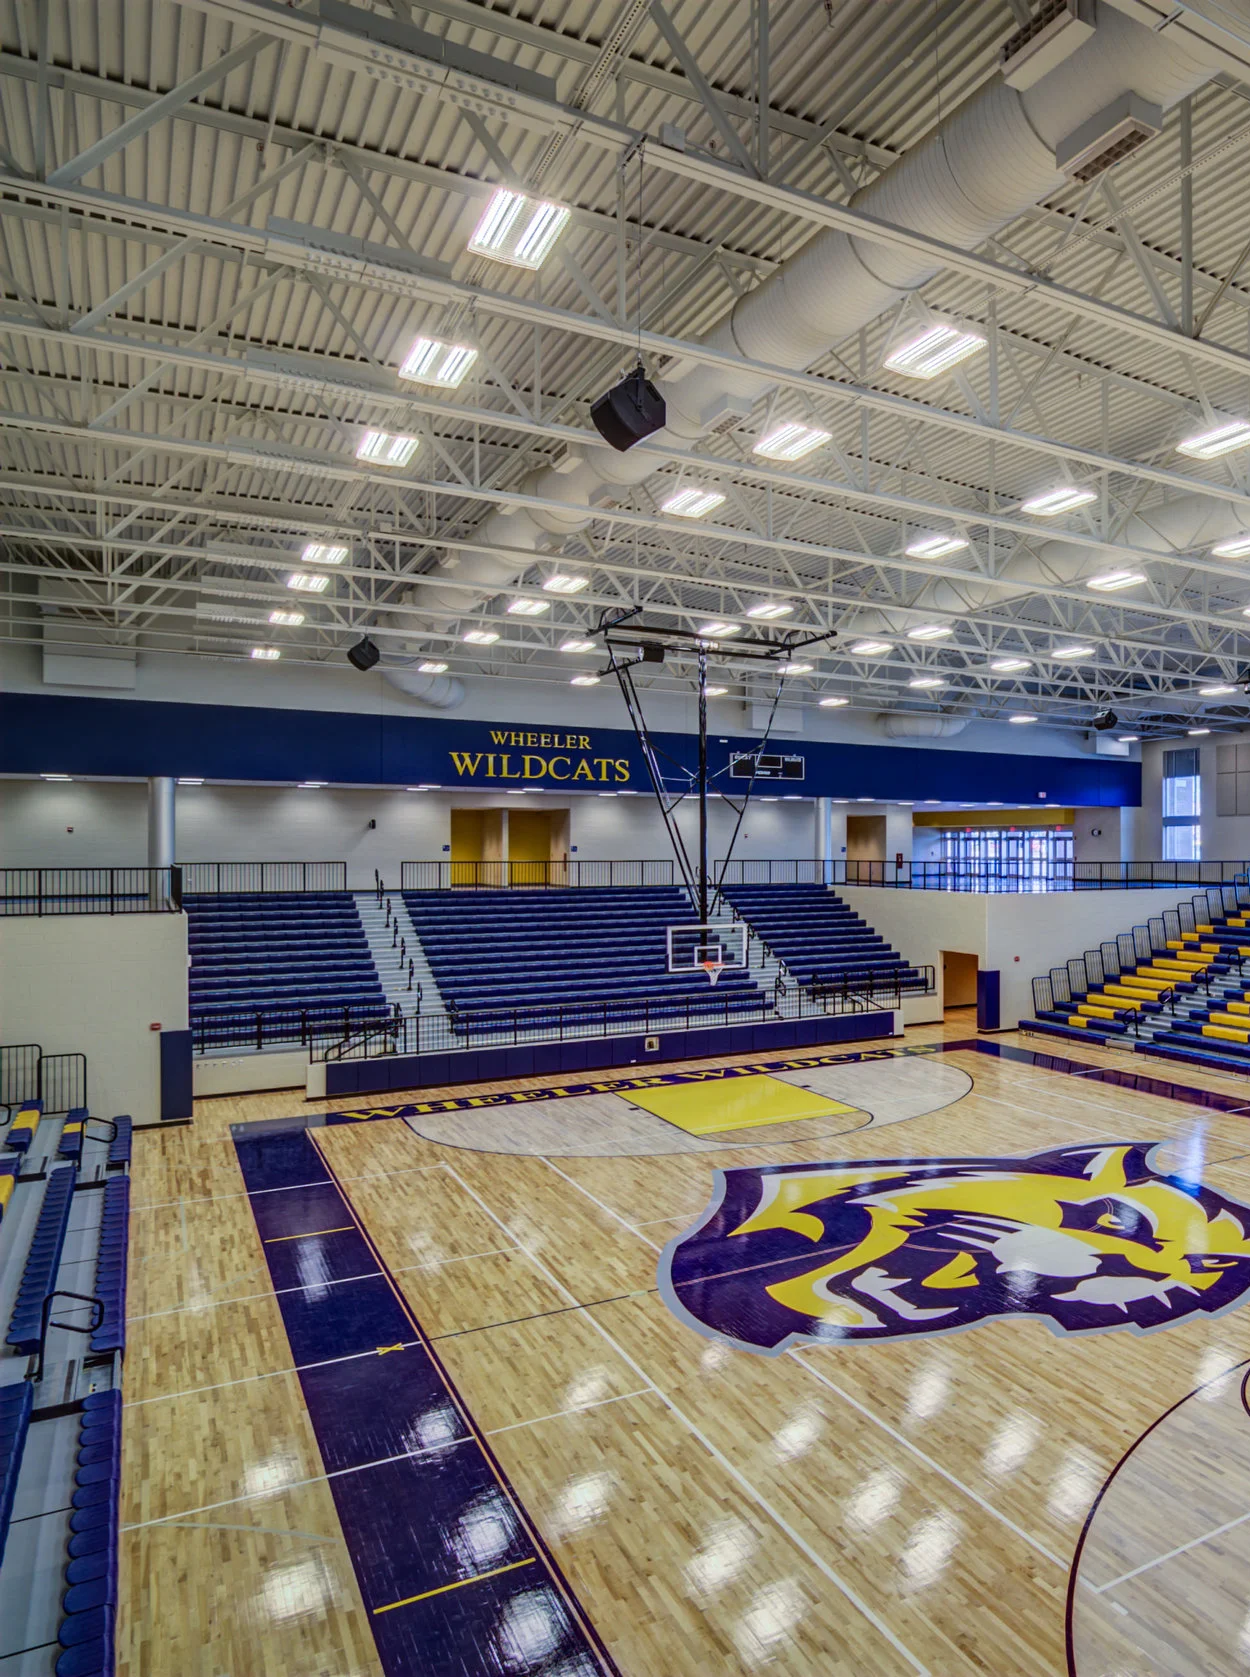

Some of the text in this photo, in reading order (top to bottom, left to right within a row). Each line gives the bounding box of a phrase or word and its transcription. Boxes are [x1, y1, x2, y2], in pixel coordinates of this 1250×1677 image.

[489, 730, 592, 750] WHEELER
[449, 751, 631, 783] WILDCATS
[336, 1044, 936, 1121] WHEELER WILDCATS
